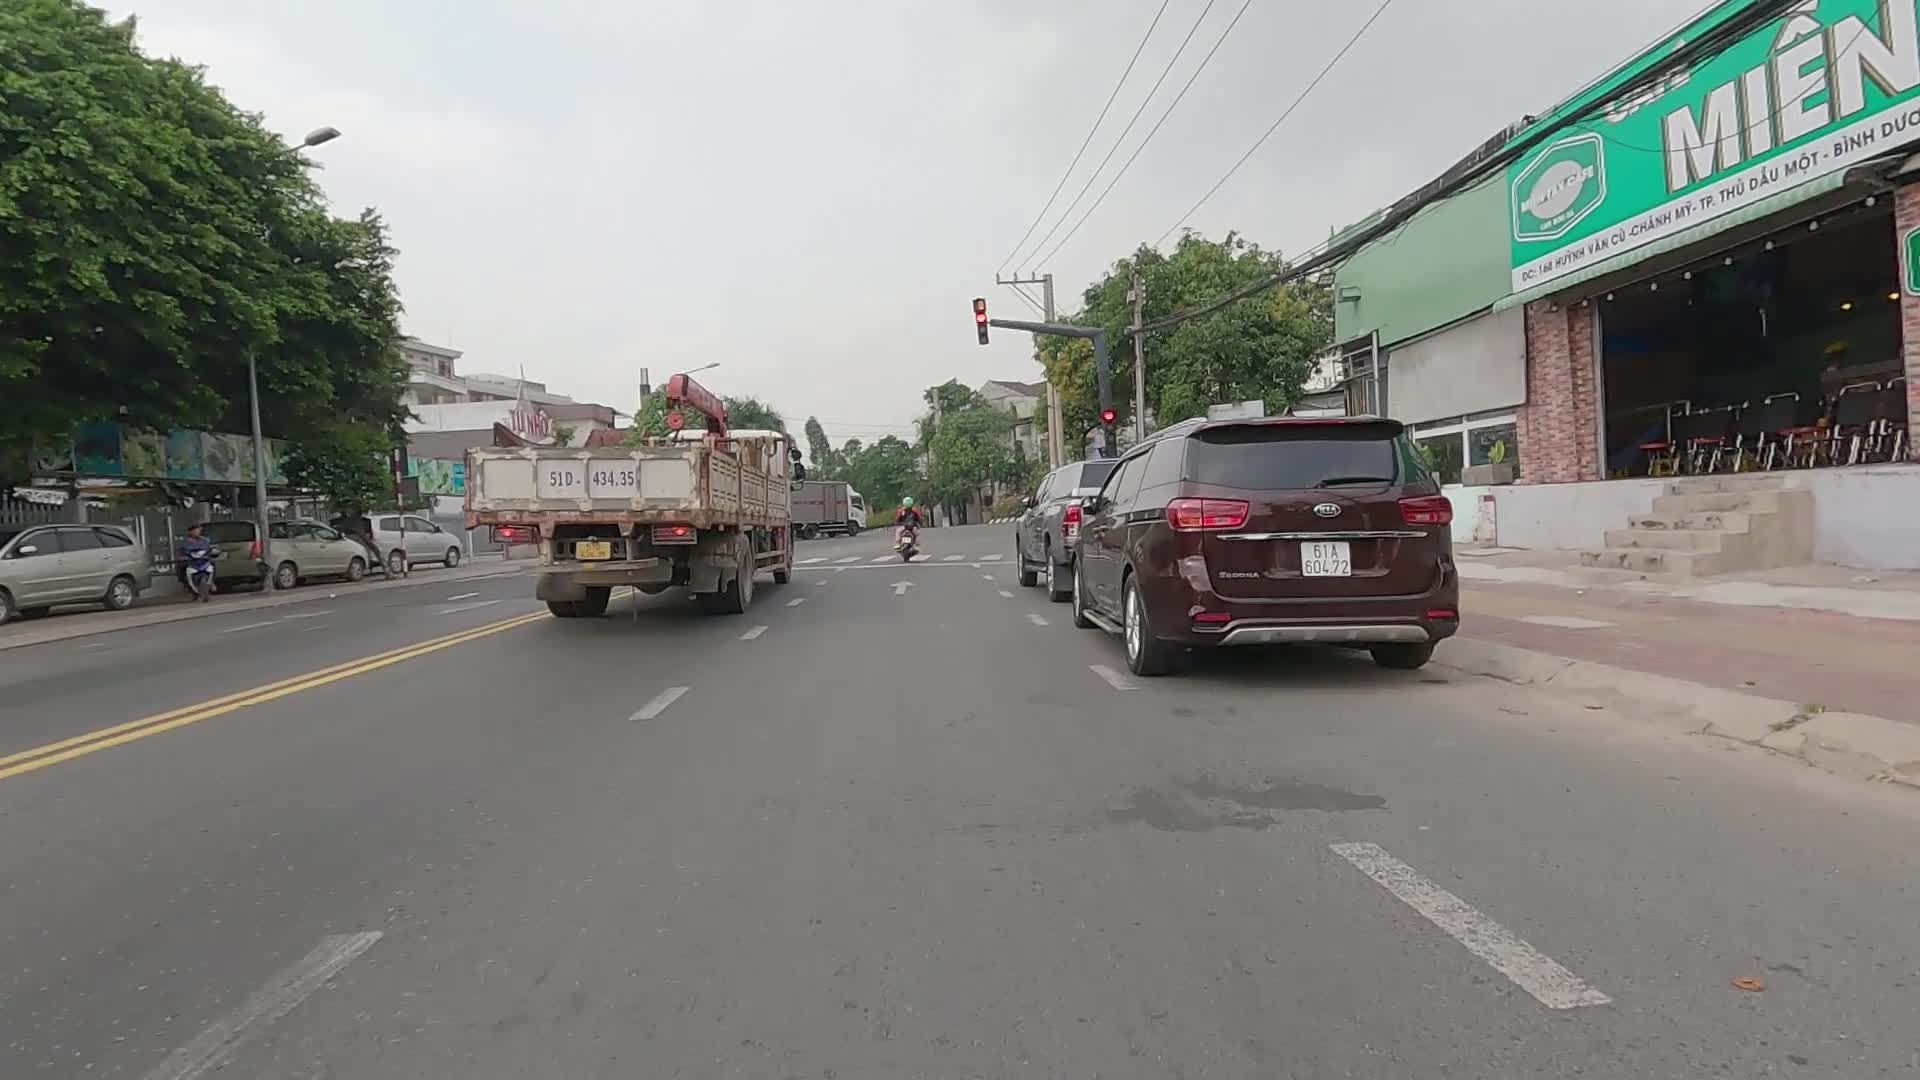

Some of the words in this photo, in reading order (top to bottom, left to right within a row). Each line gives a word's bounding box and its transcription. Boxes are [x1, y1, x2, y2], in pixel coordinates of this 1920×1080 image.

[1785, 152, 1819, 177] MỘT
[1834, 128, 1875, 157] BÌNH
[593, 471, 634, 487] 434.35
[1313, 544, 1338, 559] 61A
[1305, 560, 1349, 575] 604.72
